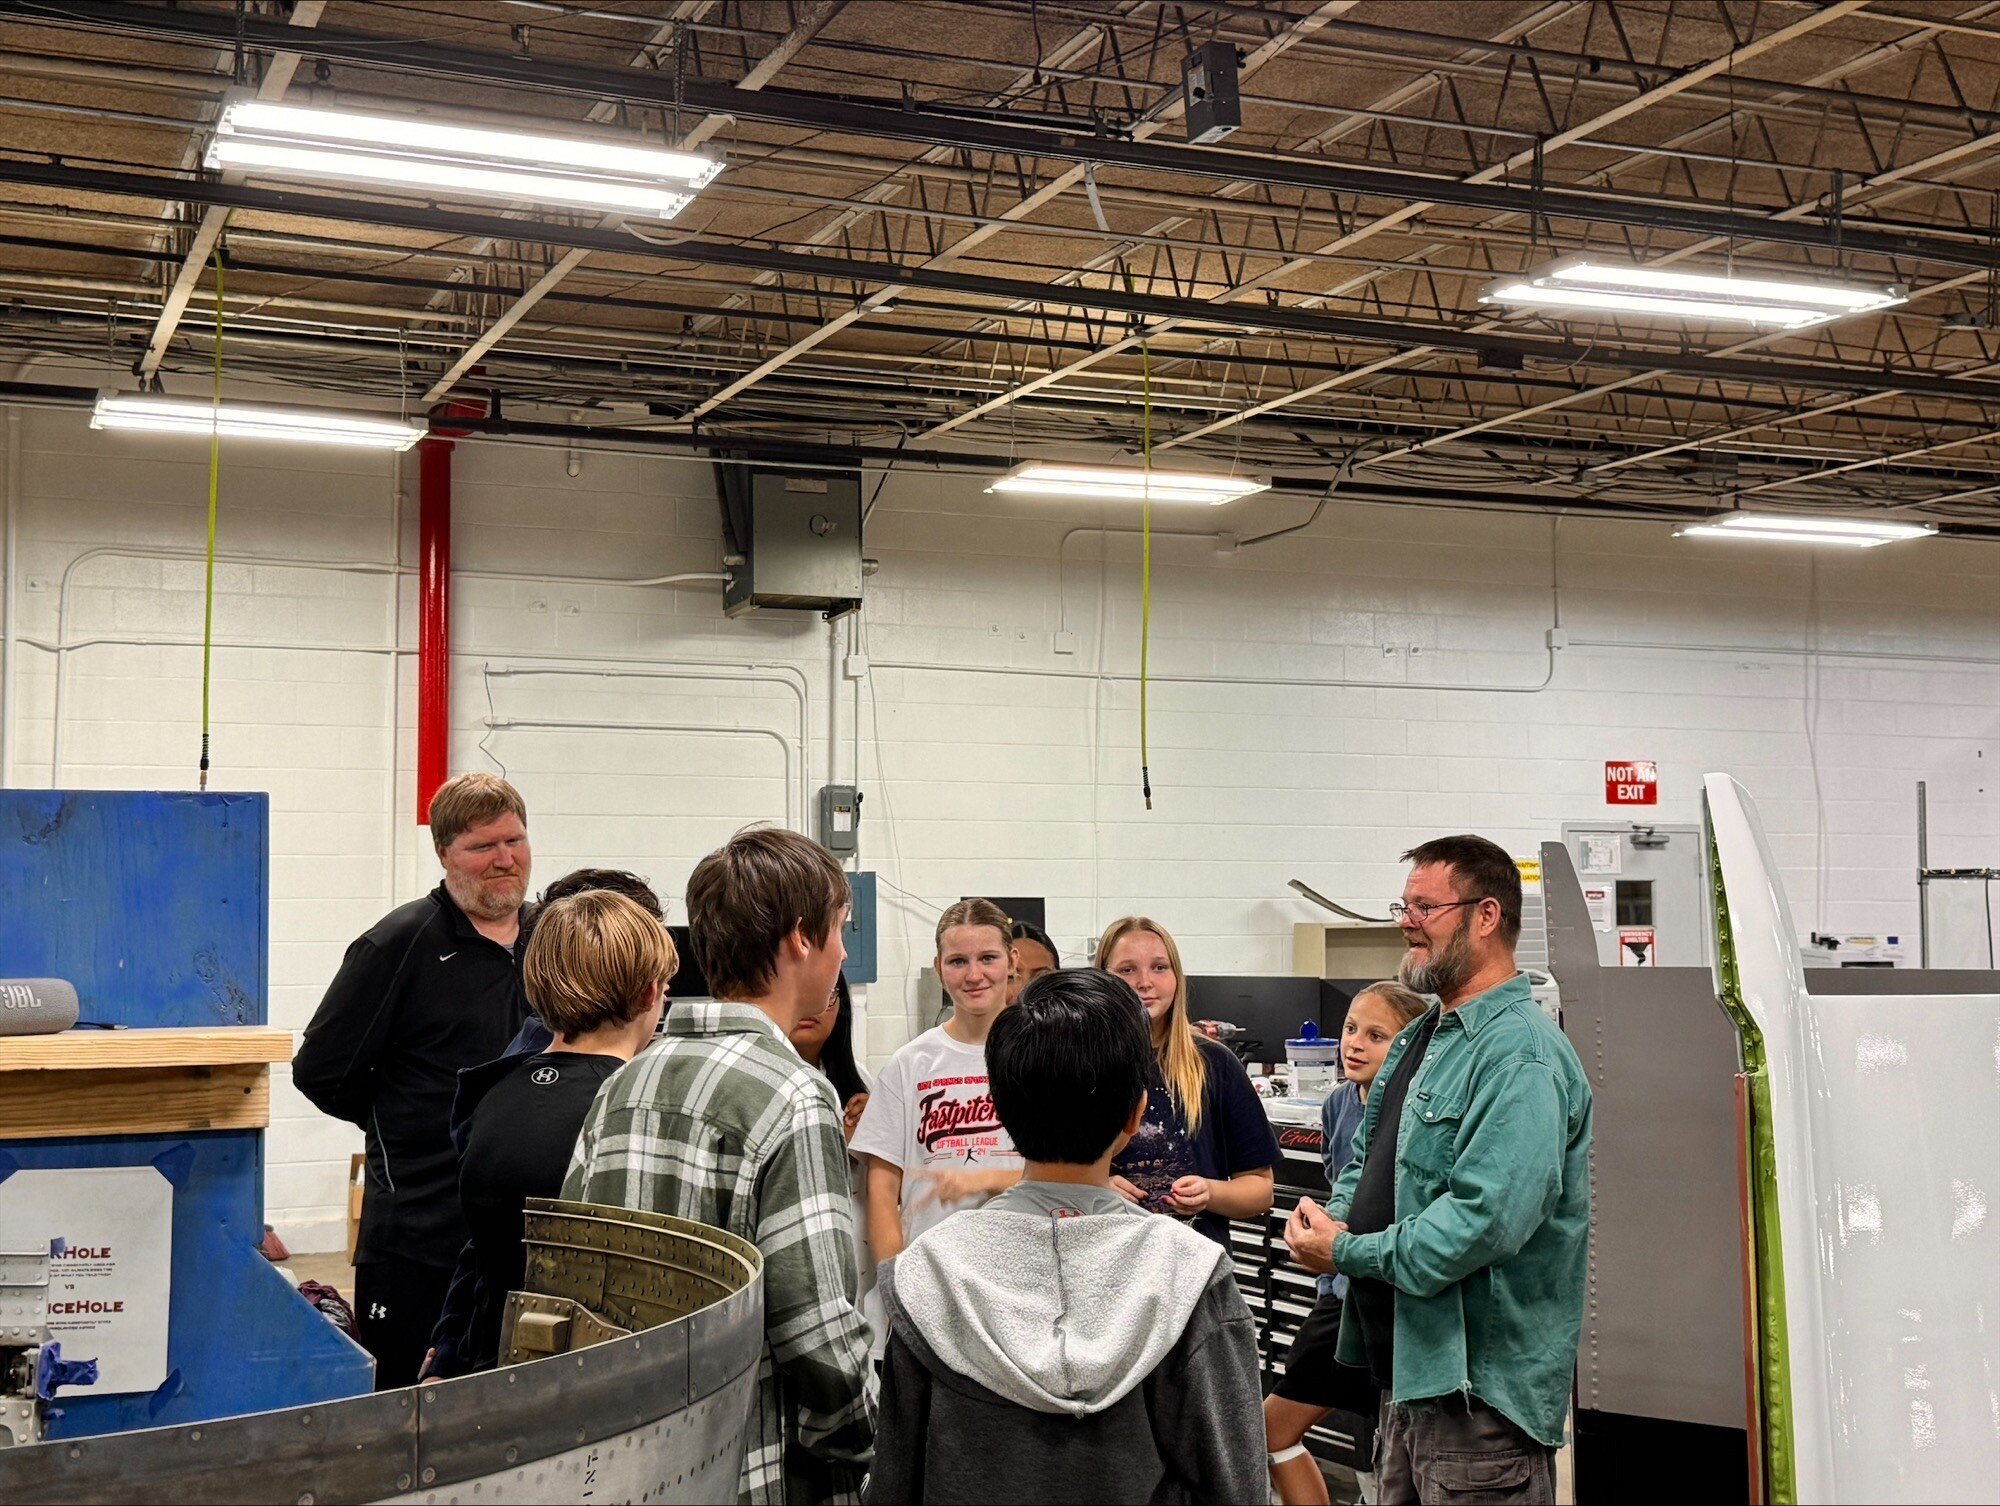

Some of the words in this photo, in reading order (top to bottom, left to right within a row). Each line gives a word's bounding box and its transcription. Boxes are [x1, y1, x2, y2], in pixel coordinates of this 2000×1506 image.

[1607, 766, 1633, 782] NOT
[1617, 784, 1645, 800] EXIT
[4, 985, 41, 1009] JBL
[972, 1137, 998, 1146] LEAGUE
[956, 1148, 965, 1156] 20
[977, 1147, 986, 1155] 24
